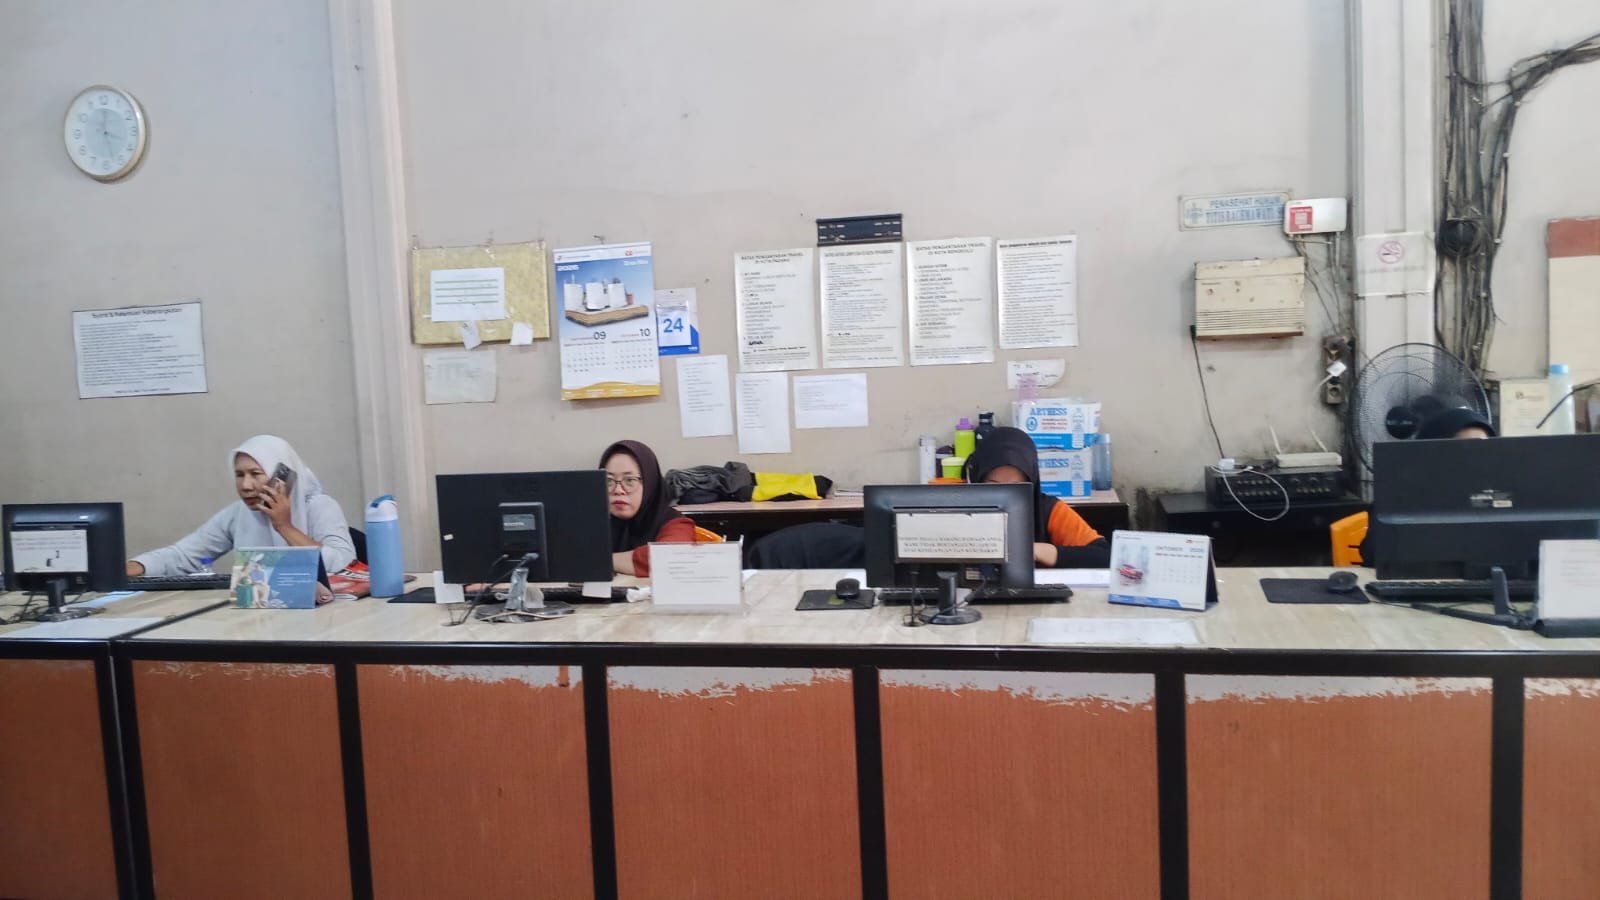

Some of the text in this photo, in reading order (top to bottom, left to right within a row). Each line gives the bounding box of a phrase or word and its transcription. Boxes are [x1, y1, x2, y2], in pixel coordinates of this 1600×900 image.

[99, 95, 108, 105] 12
[125, 110, 133, 121] 2
[73, 128, 81, 140] 9
[130, 126, 137, 137] 3
[79, 145, 86, 156] 8
[126, 143, 134, 152] 4
[90, 156, 97, 166] 7
[1210, 195, 1281, 208] PENASEHAT HUKUM
[663, 317, 684, 334] 24
[593, 331, 606, 341] 09
[639, 328, 652, 338] 10
[1039, 459, 1069, 468] THESS
